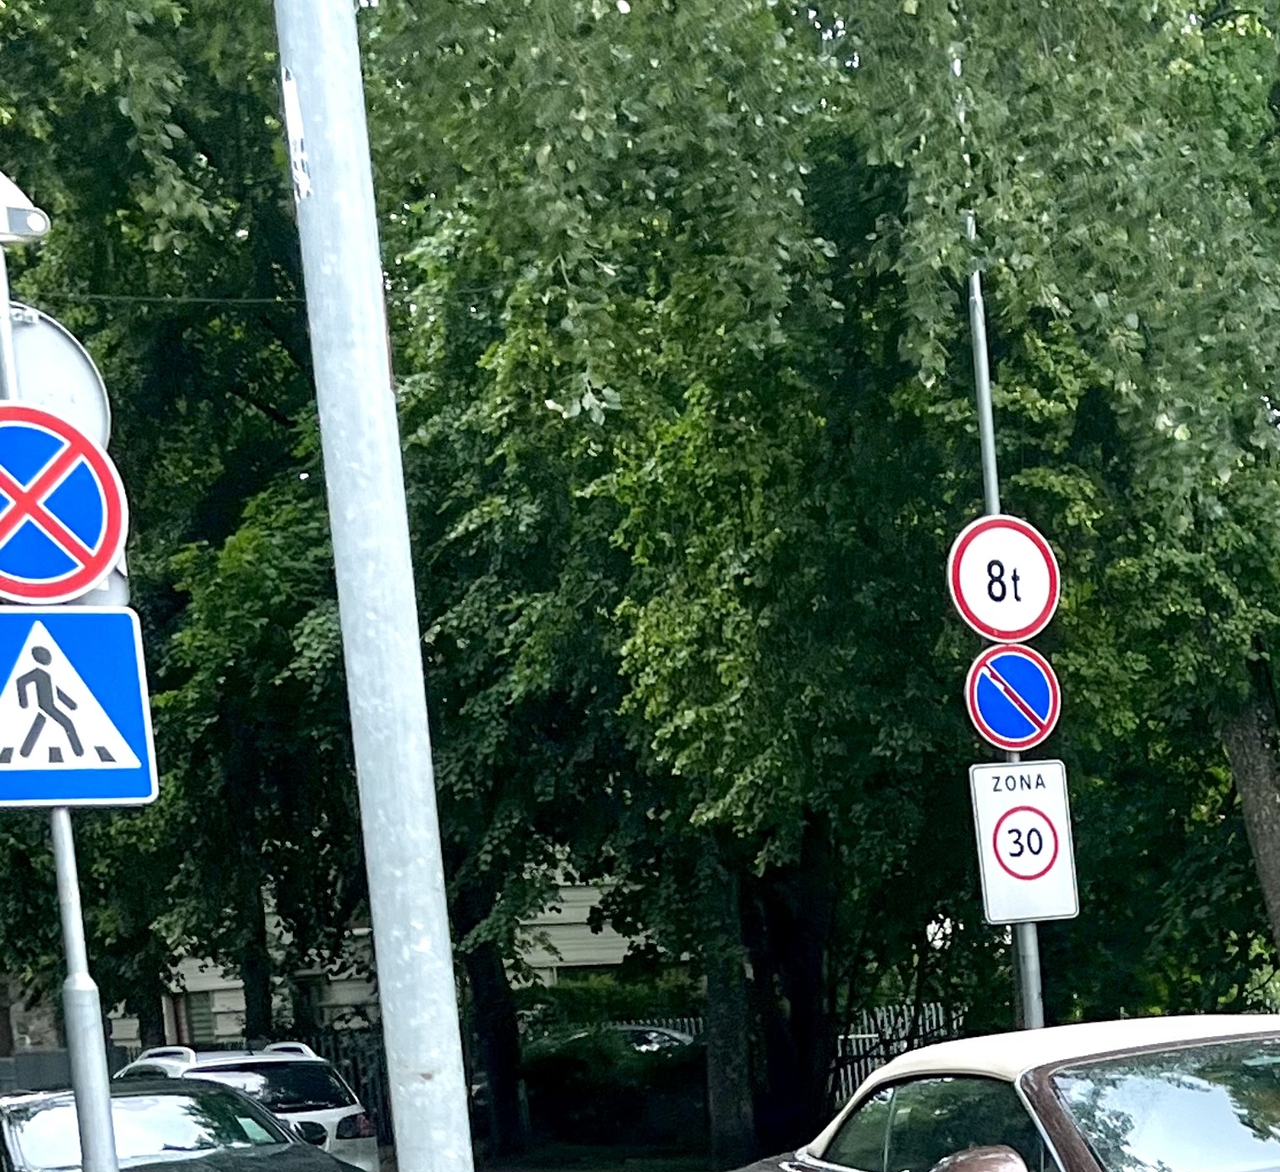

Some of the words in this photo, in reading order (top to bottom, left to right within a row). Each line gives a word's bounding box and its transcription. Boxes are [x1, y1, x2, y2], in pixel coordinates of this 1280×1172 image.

[987, 559, 1022, 603] 8t
[991, 773, 1047, 792] ZONA
[1007, 827, 1043, 858] 30
